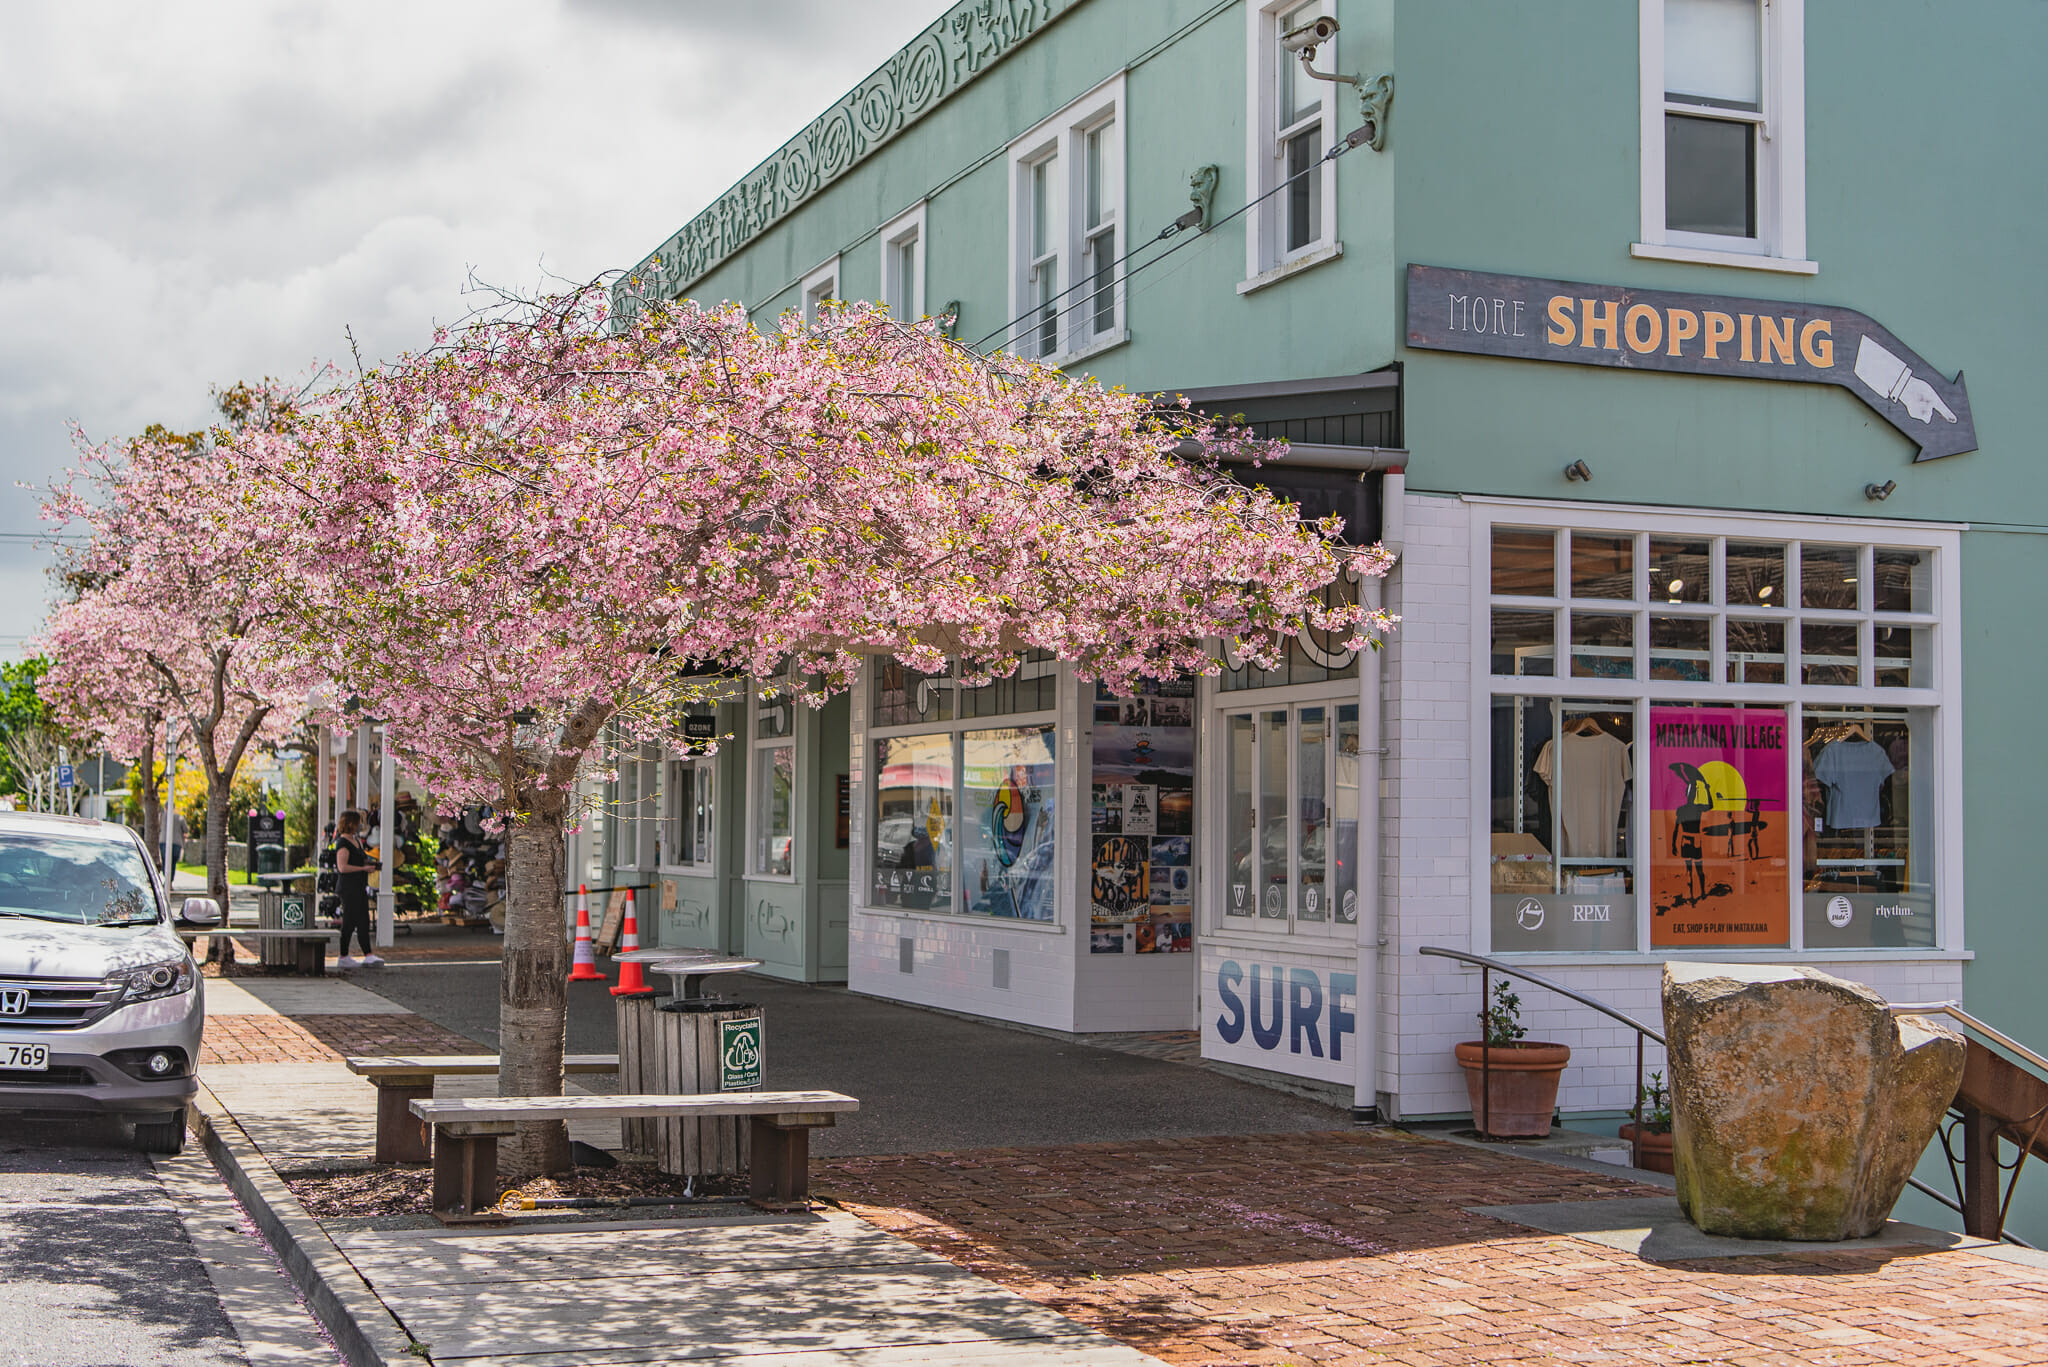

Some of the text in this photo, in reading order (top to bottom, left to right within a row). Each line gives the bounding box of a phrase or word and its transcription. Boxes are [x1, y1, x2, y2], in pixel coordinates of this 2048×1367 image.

[1448, 294, 1834, 368] MORE SHOPPING
[1656, 723, 1783, 750] MATAKANA VILLAGE
[61, 767, 70, 780] P
[1572, 904, 1611, 922] RPM
[1672, 922, 1768, 935] EAT, SHOP & PLAY IN MATAKANA
[1217, 960, 1357, 1061] SURF
[725, 1021, 758, 1032] Recyclable
